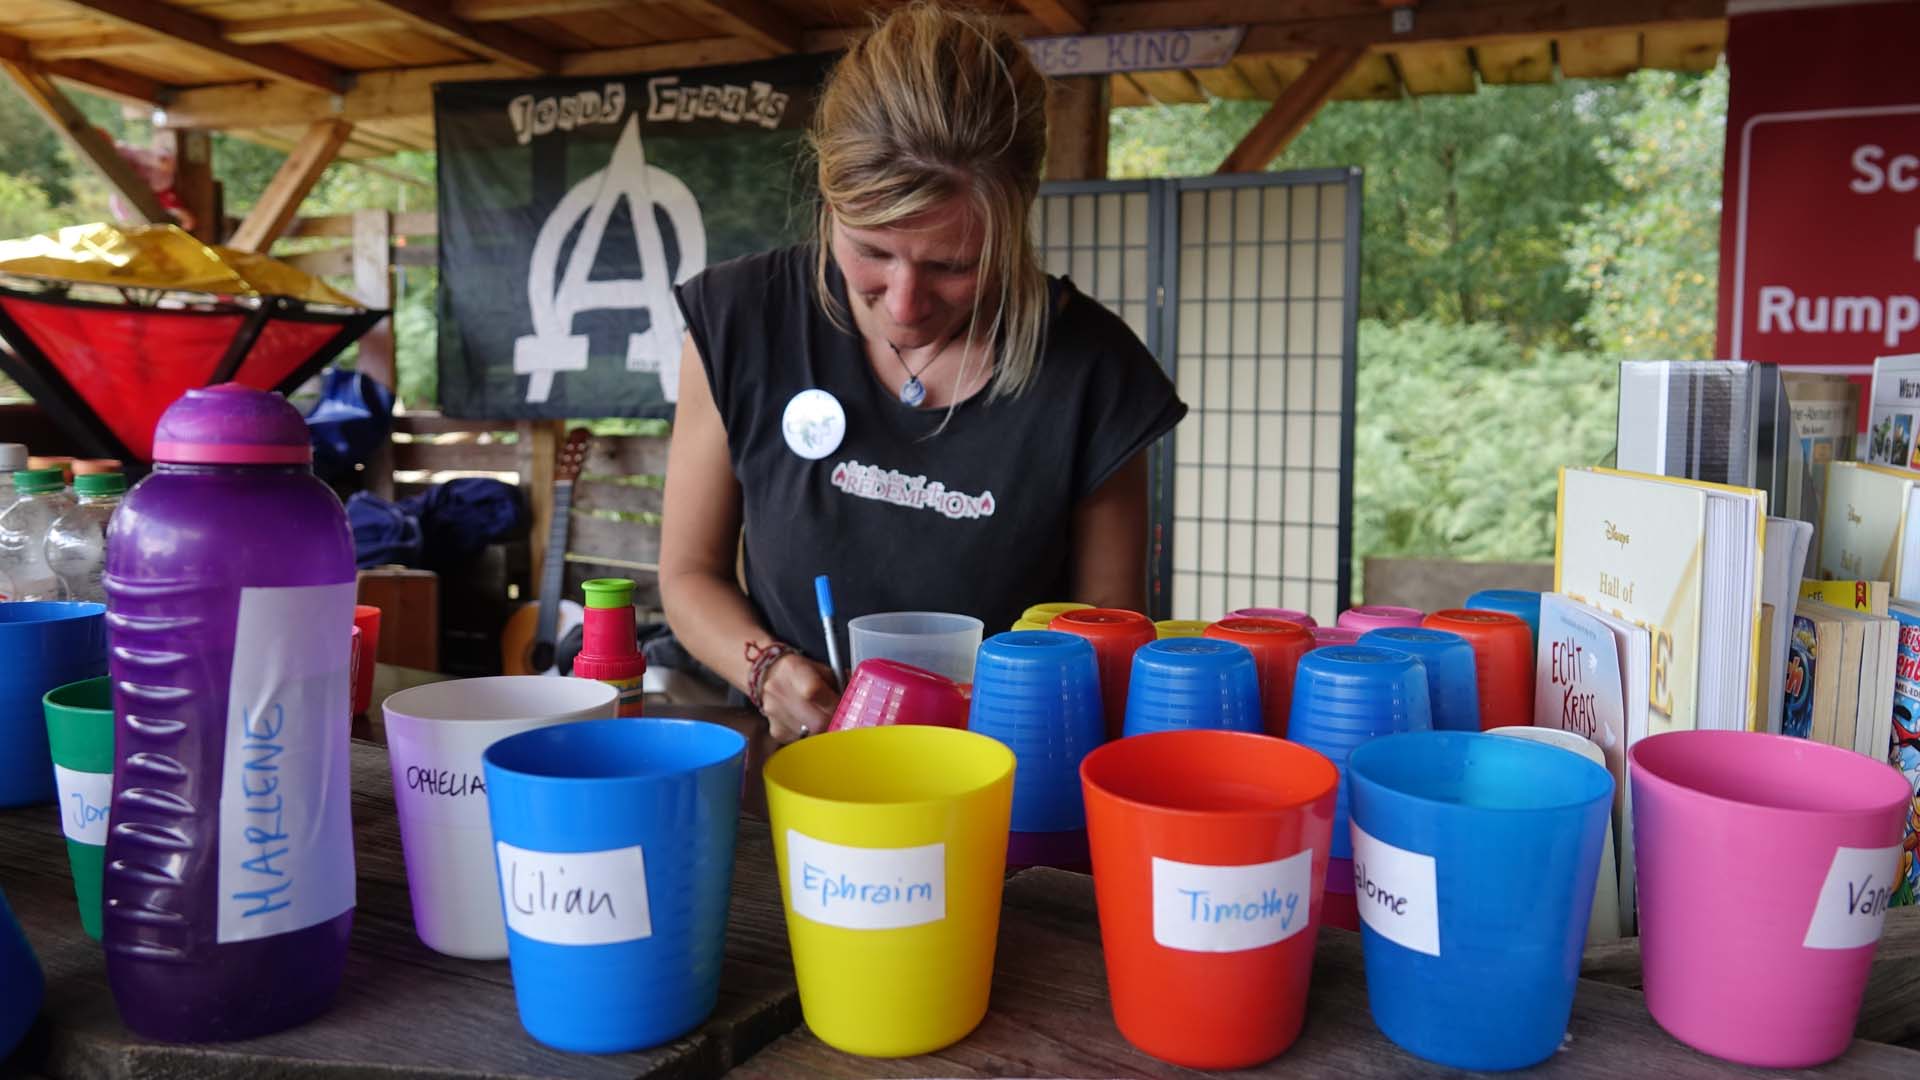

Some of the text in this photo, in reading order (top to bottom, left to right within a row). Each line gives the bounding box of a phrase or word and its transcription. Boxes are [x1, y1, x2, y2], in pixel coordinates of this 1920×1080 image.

[1106, 32, 1191, 68] KINO
[509, 77, 789, 144] Jesus Freaks
[1758, 286, 1920, 348] Rump
[1599, 571, 1635, 604] Hall of
[1552, 636, 1583, 686] ECHT
[1562, 684, 1598, 741] KRASS
[406, 764, 487, 797] OPHELIA
[511, 860, 618, 920] Lilian
[802, 861, 934, 907] Ephraim
[1177, 887, 1299, 932] Timothy
